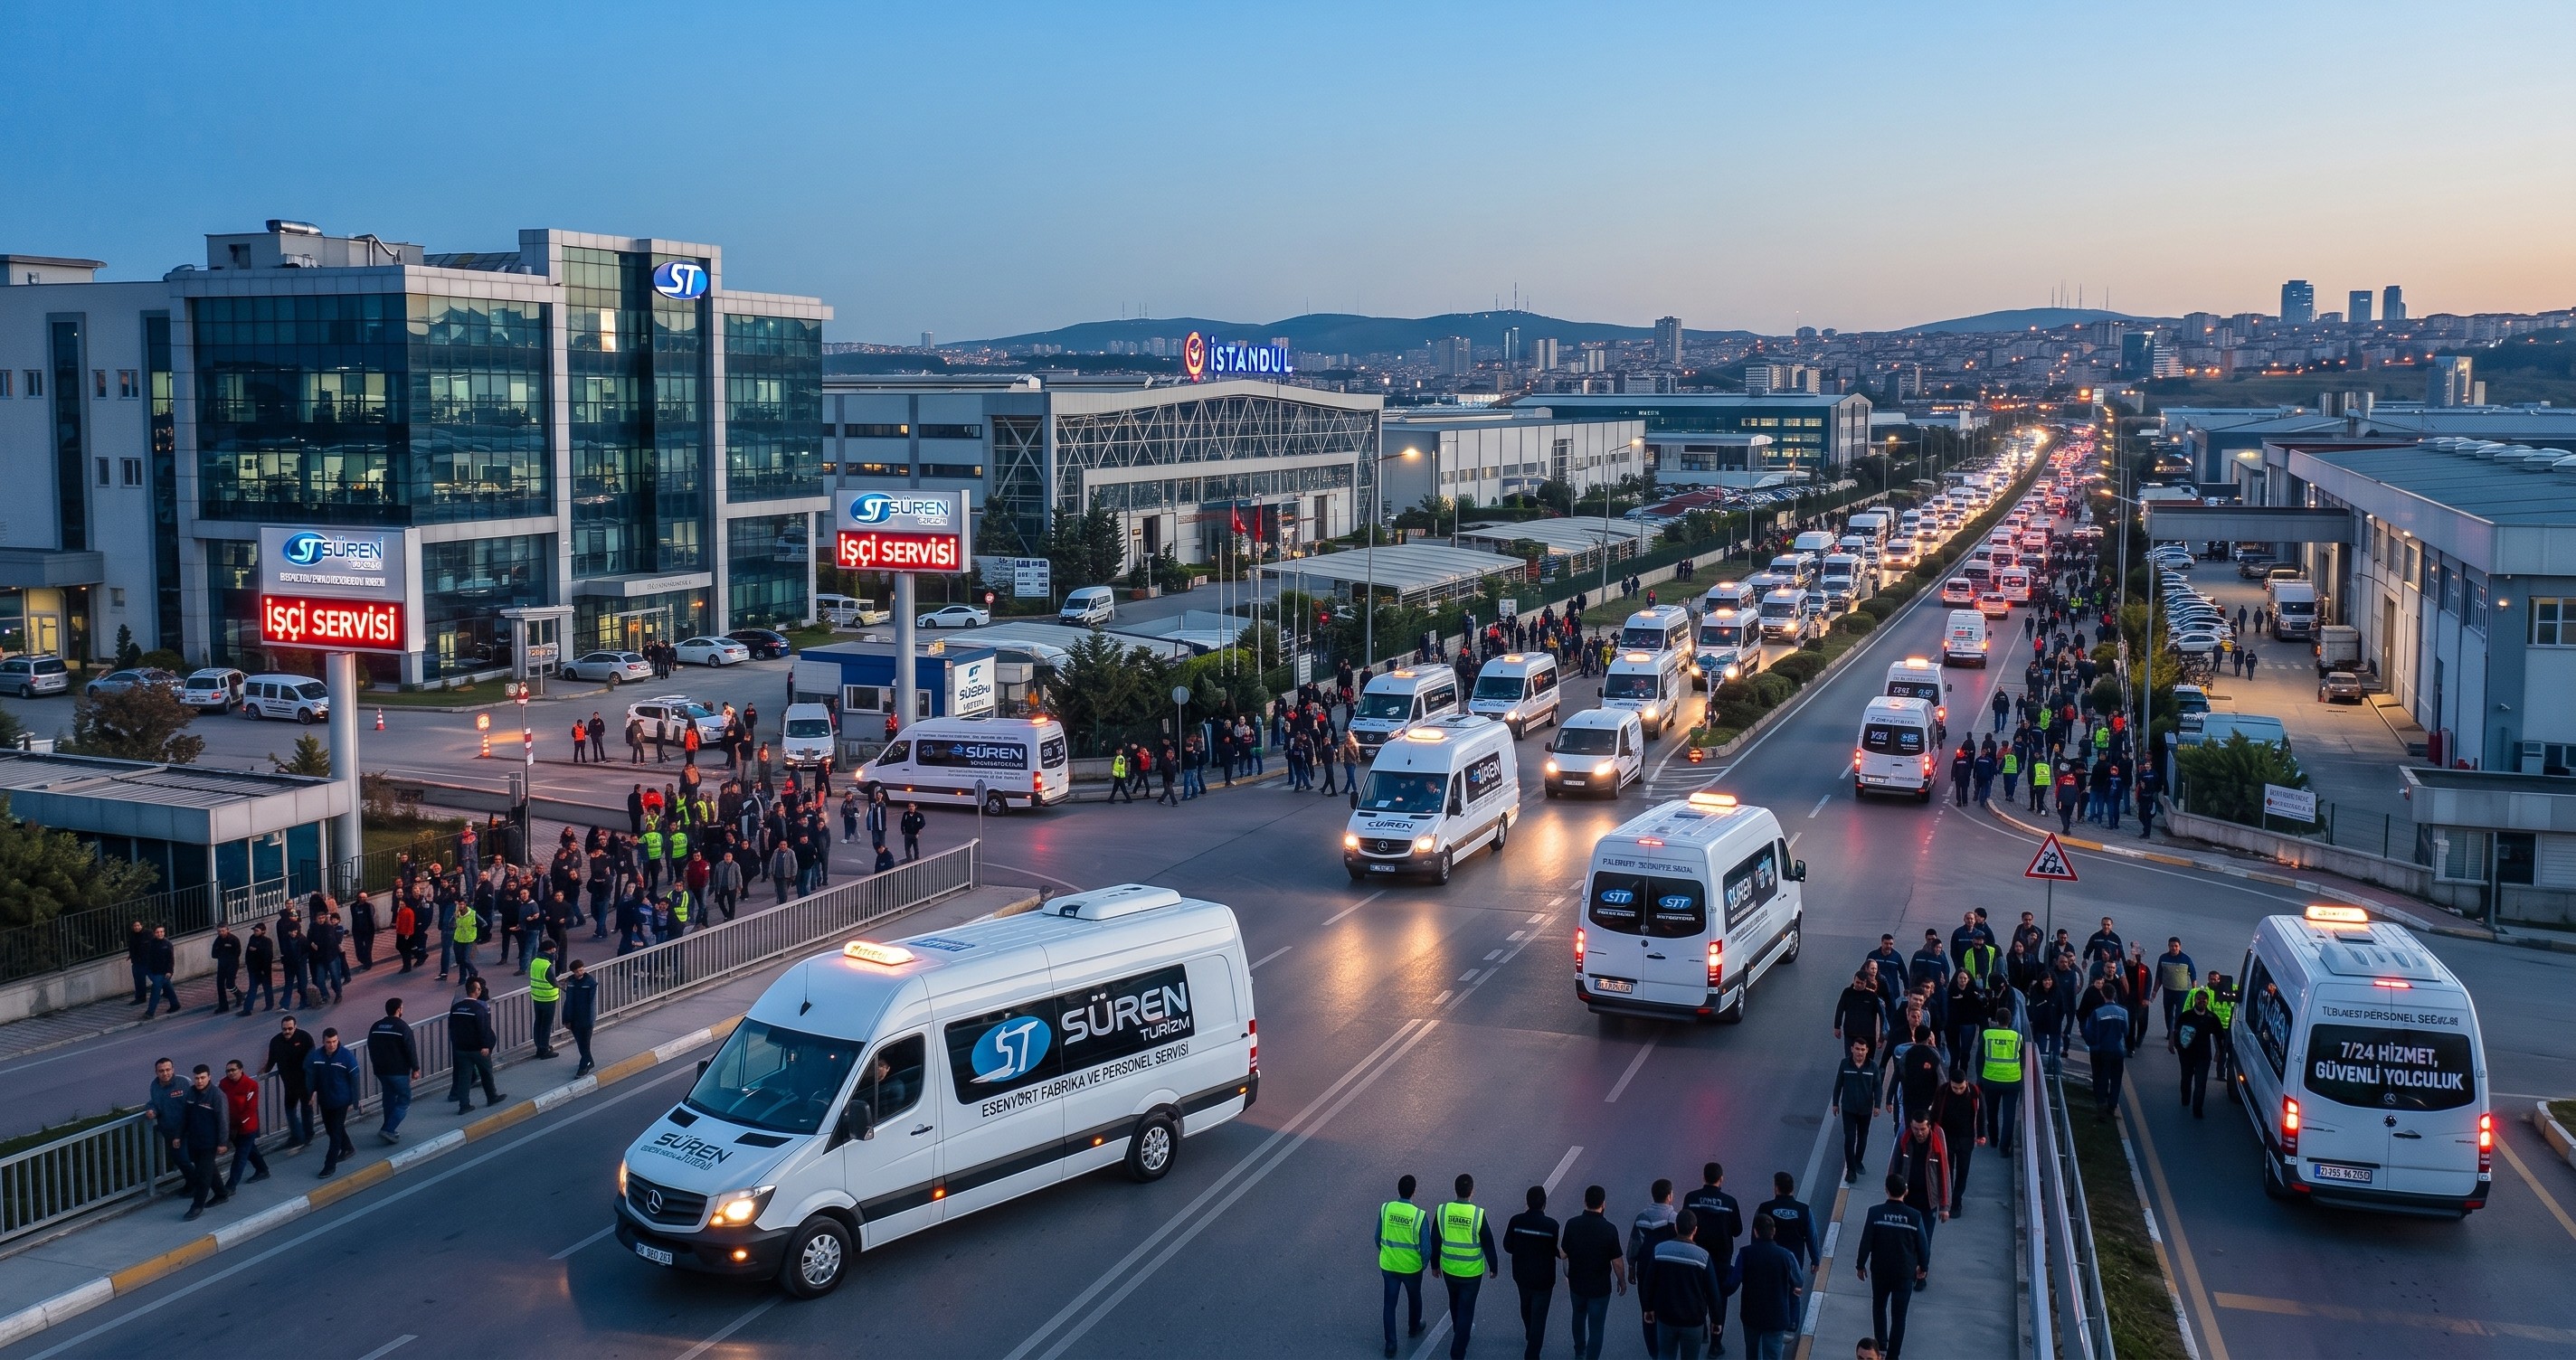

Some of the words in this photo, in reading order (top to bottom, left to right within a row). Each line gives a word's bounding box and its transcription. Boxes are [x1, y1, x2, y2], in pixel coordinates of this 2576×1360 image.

[656, 263, 703, 296] ST
[1210, 335, 1293, 373] İSTANDUL
[889, 496, 950, 515] SÜREN
[321, 535, 384, 560] SÜREN
[840, 533, 876, 567] İŞÇİ
[881, 536, 955, 565] SERVİSİ
[266, 598, 306, 641] İŞÇİ
[312, 605, 395, 641] SERVİSİ
[965, 744, 1023, 760] SÜREN
[1061, 982, 1188, 1045] SÜREN
[1140, 1015, 1190, 1041] TURİZM
[2364, 1010, 2416, 1023] PERSONEL
[970, 1020, 1038, 1084] ST
[2341, 1041, 2374, 1060] 7/24
[2378, 1042, 2439, 1068] HİZMET,
[1087, 1069, 1101, 1085] VE
[1103, 1054, 1153, 1081] PERSONEL
[2316, 1060, 2381, 1084] GÜVENLİ
[2384, 1068, 2464, 1091] YOLCULUK
[653, 1132, 734, 1165] SÜREN
